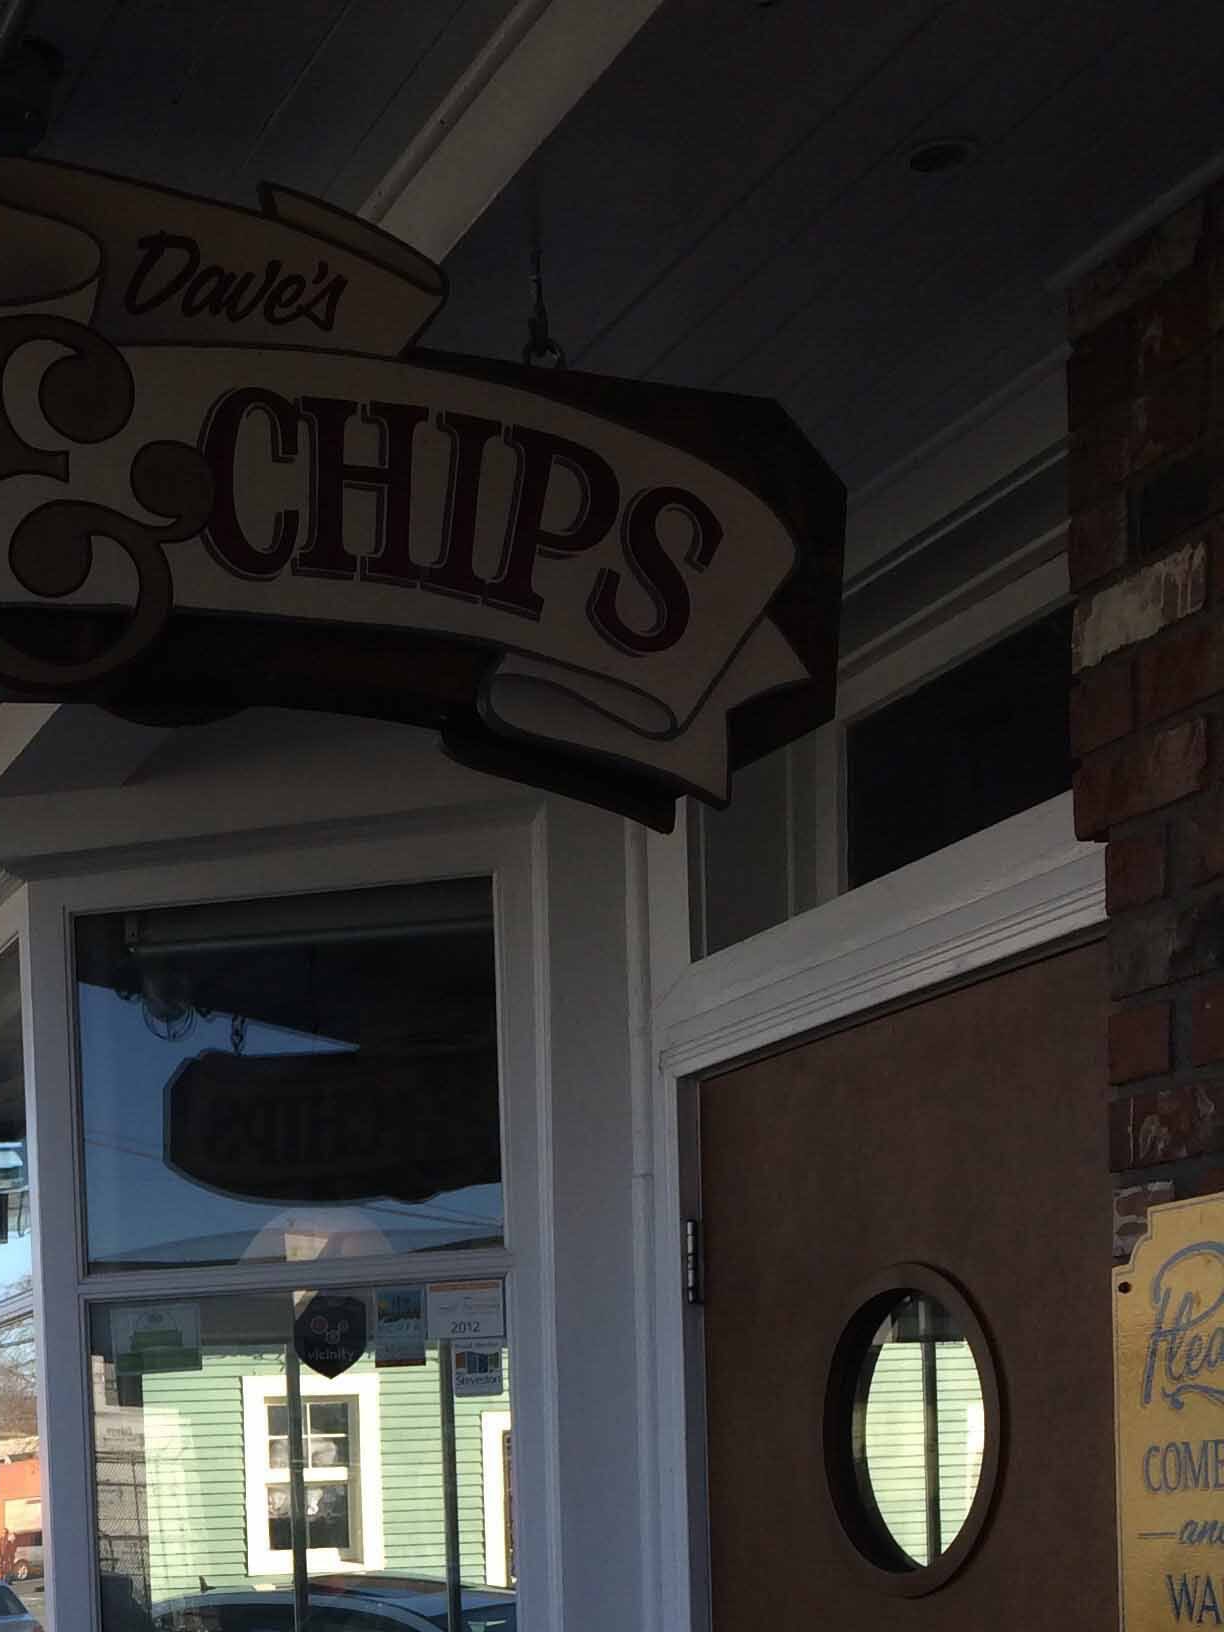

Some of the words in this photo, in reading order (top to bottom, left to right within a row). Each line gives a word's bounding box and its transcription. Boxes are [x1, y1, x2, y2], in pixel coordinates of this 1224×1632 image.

[123, 229, 350, 332] Dave's
[198, 386, 724, 657] CHIPS
[451, 1320, 480, 1334] 2012
